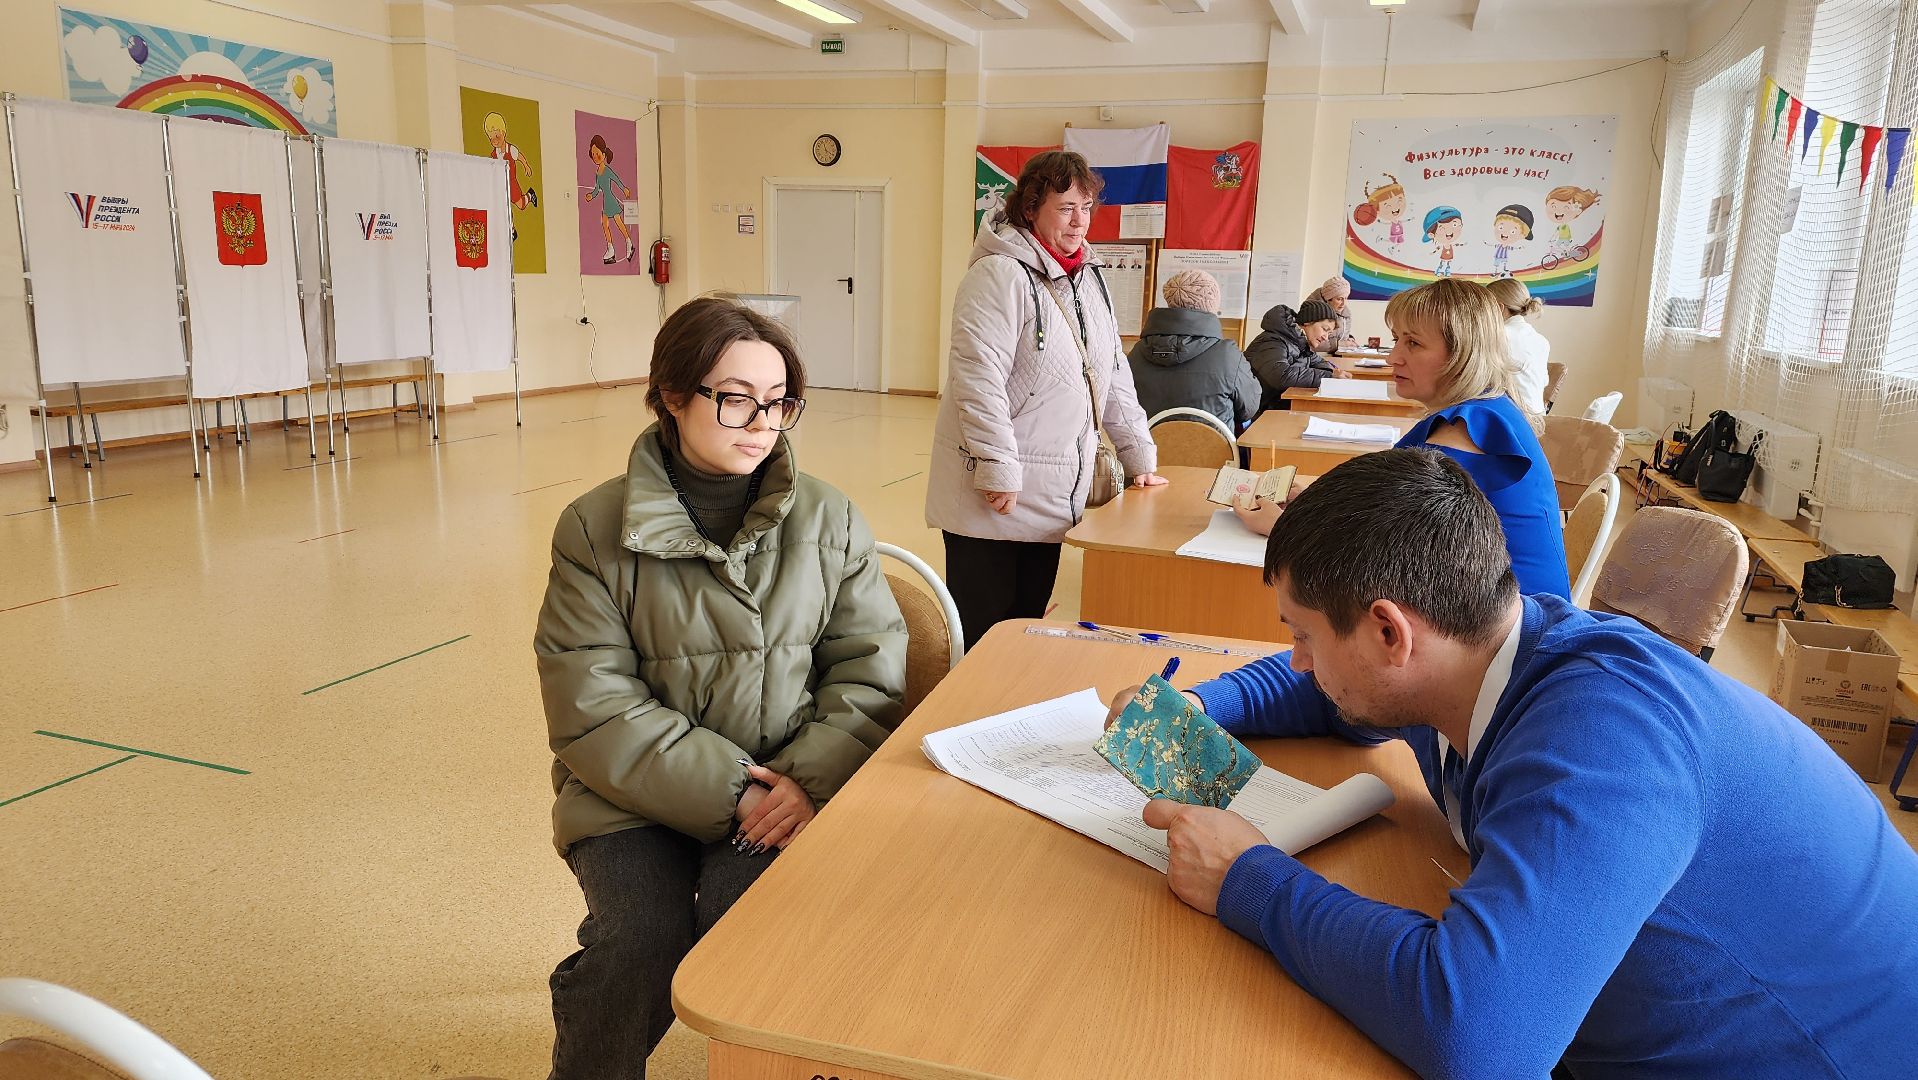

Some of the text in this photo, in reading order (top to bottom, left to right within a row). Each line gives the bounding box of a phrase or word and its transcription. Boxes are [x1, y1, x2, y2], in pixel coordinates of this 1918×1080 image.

[1404, 146, 1489, 163] Физкультура
[1503, 146, 1525, 155] это
[1529, 149, 1573, 164] класс!
[1423, 166, 1550, 180] Все здоровые у нас!
